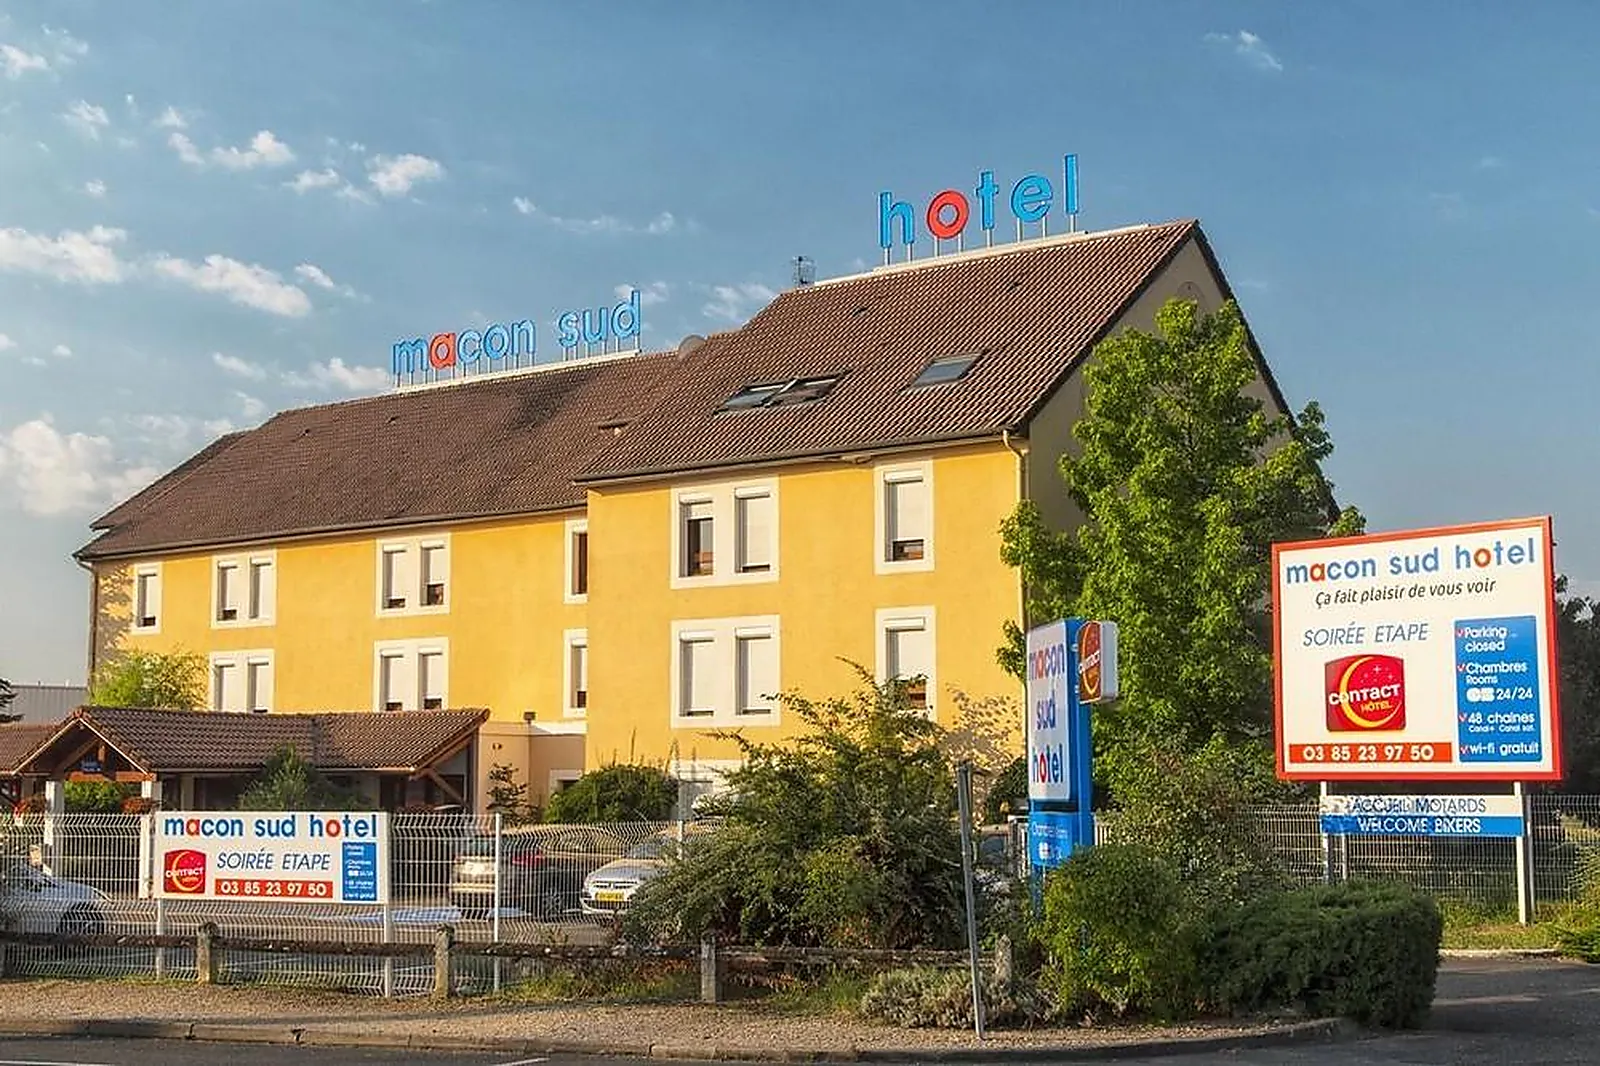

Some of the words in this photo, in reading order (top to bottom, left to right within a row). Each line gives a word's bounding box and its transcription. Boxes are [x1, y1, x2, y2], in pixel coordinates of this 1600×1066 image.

[879, 153, 1079, 248] hotel
[393, 320, 536, 375] macon
[558, 289, 641, 348] sud
[1286, 558, 1376, 584] macon
[1389, 546, 1439, 575] sud
[1455, 537, 1535, 570] hotel
[1316, 591, 1331, 609] Ça
[1334, 588, 1358, 605] fait
[1360, 586, 1405, 605] plaisir
[1408, 583, 1426, 598] de
[1430, 582, 1463, 597] vous
[1467, 577, 1497, 593] voir
[1303, 621, 1365, 647] SOIRÉE
[1374, 623, 1429, 643] ETAPE
[1465, 626, 1508, 640] Parking
[1465, 640, 1506, 653] closed
[1029, 641, 1065, 681] macon
[1466, 661, 1528, 674] Chambres
[1496, 686, 1534, 700] 24/24
[1036, 689, 1057, 731] sud
[1468, 712, 1483, 724] 48
[1303, 745, 1325, 761] 03
[1331, 745, 1351, 761] 85
[1358, 745, 1378, 761] 23
[1385, 744, 1404, 761] 97
[1411, 744, 1435, 761] 50
[1469, 742, 1495, 755] wi-fi
[1500, 741, 1540, 757] gratuit
[1032, 742, 1064, 784] hotel
[164, 816, 244, 837] macon
[255, 814, 296, 837] sud
[309, 814, 377, 837] hotel
[1357, 818, 1428, 833] WELCOME
[1434, 817, 1481, 833] BIKERS
[216, 848, 274, 871] SOIRÉE
[282, 852, 331, 871] ETAPE
[221, 881, 239, 894] 03
[244, 881, 260, 895] 85
[266, 881, 282, 895] 23
[287, 881, 303, 896] 97
[308, 882, 327, 896] 50
